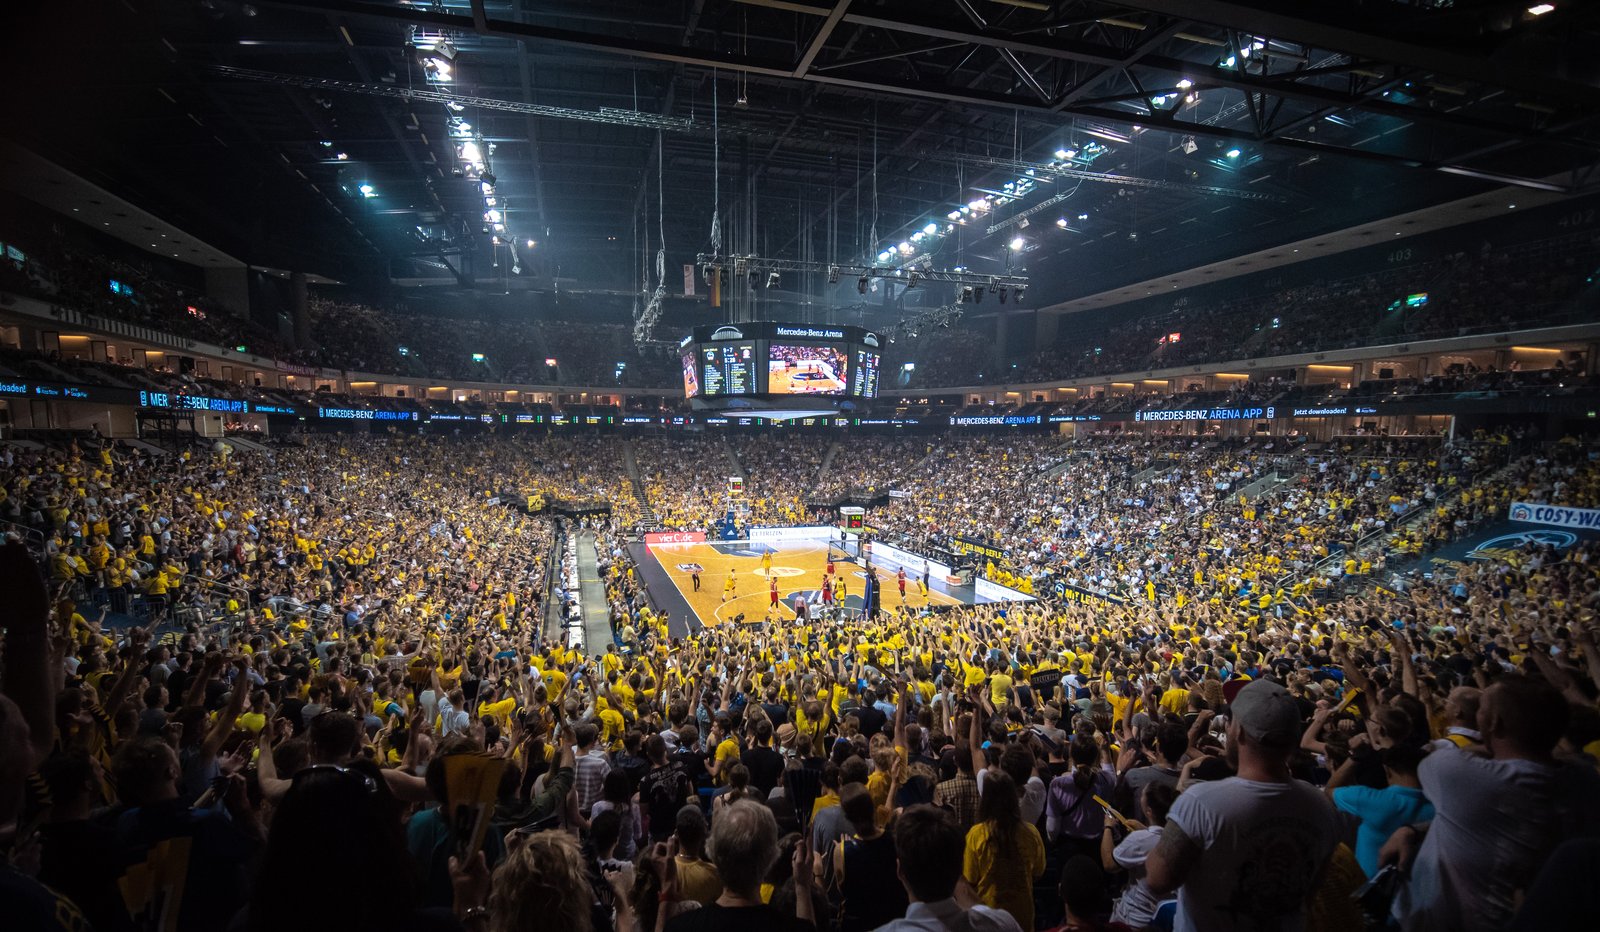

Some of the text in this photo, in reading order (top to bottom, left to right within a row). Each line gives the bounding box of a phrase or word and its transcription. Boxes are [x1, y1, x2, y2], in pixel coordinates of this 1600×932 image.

[1557, 209, 1595, 227] 402
[1387, 248, 1412, 263] 403
[777, 327, 843, 338] Mercedes-Benz Arena
[210, 400, 230, 411] ARENA
[230, 401, 242, 412] APP
[325, 408, 410, 420] MERCEDES-BENZ ARENA APP
[957, 416, 1004, 424] MERCEDES-BENZ
[1143, 408, 1262, 420] MERCEDES-BENZ ARENA APP
[1535, 507, 1600, 527] COSY-WA
